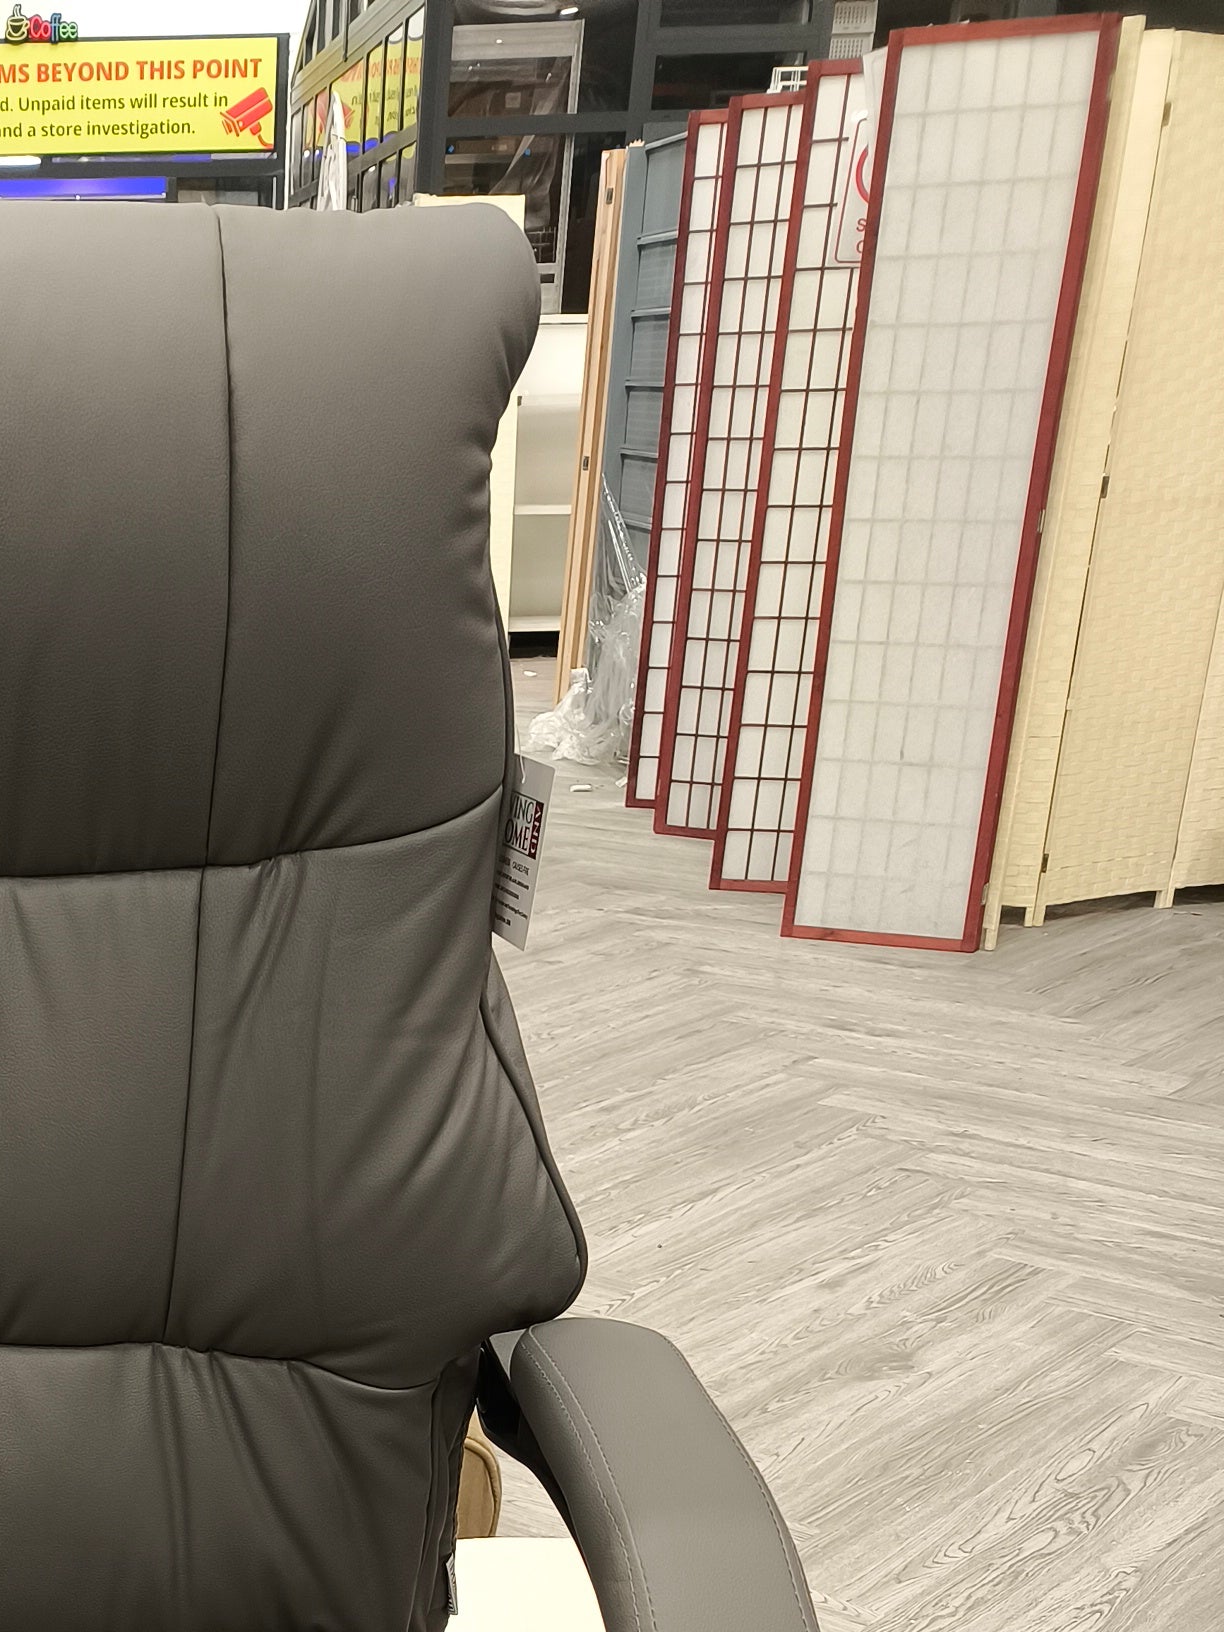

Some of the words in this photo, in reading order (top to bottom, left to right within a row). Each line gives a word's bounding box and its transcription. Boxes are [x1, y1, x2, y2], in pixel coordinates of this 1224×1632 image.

[29, 13, 78, 43] Coffee
[37, 61, 129, 83] BEYOND
[136, 59, 185, 80] THIS
[192, 58, 263, 79] POINT
[18, 95, 76, 116] Unpaid
[80, 94, 125, 110] items
[130, 93, 157, 109] will
[162, 92, 209, 108] result
[213, 92, 228, 108] in
[27, 125, 36, 138] a
[41, 123, 82, 138] store
[86, 119, 196, 140] investigation.
[504, 818, 531, 852] OME
